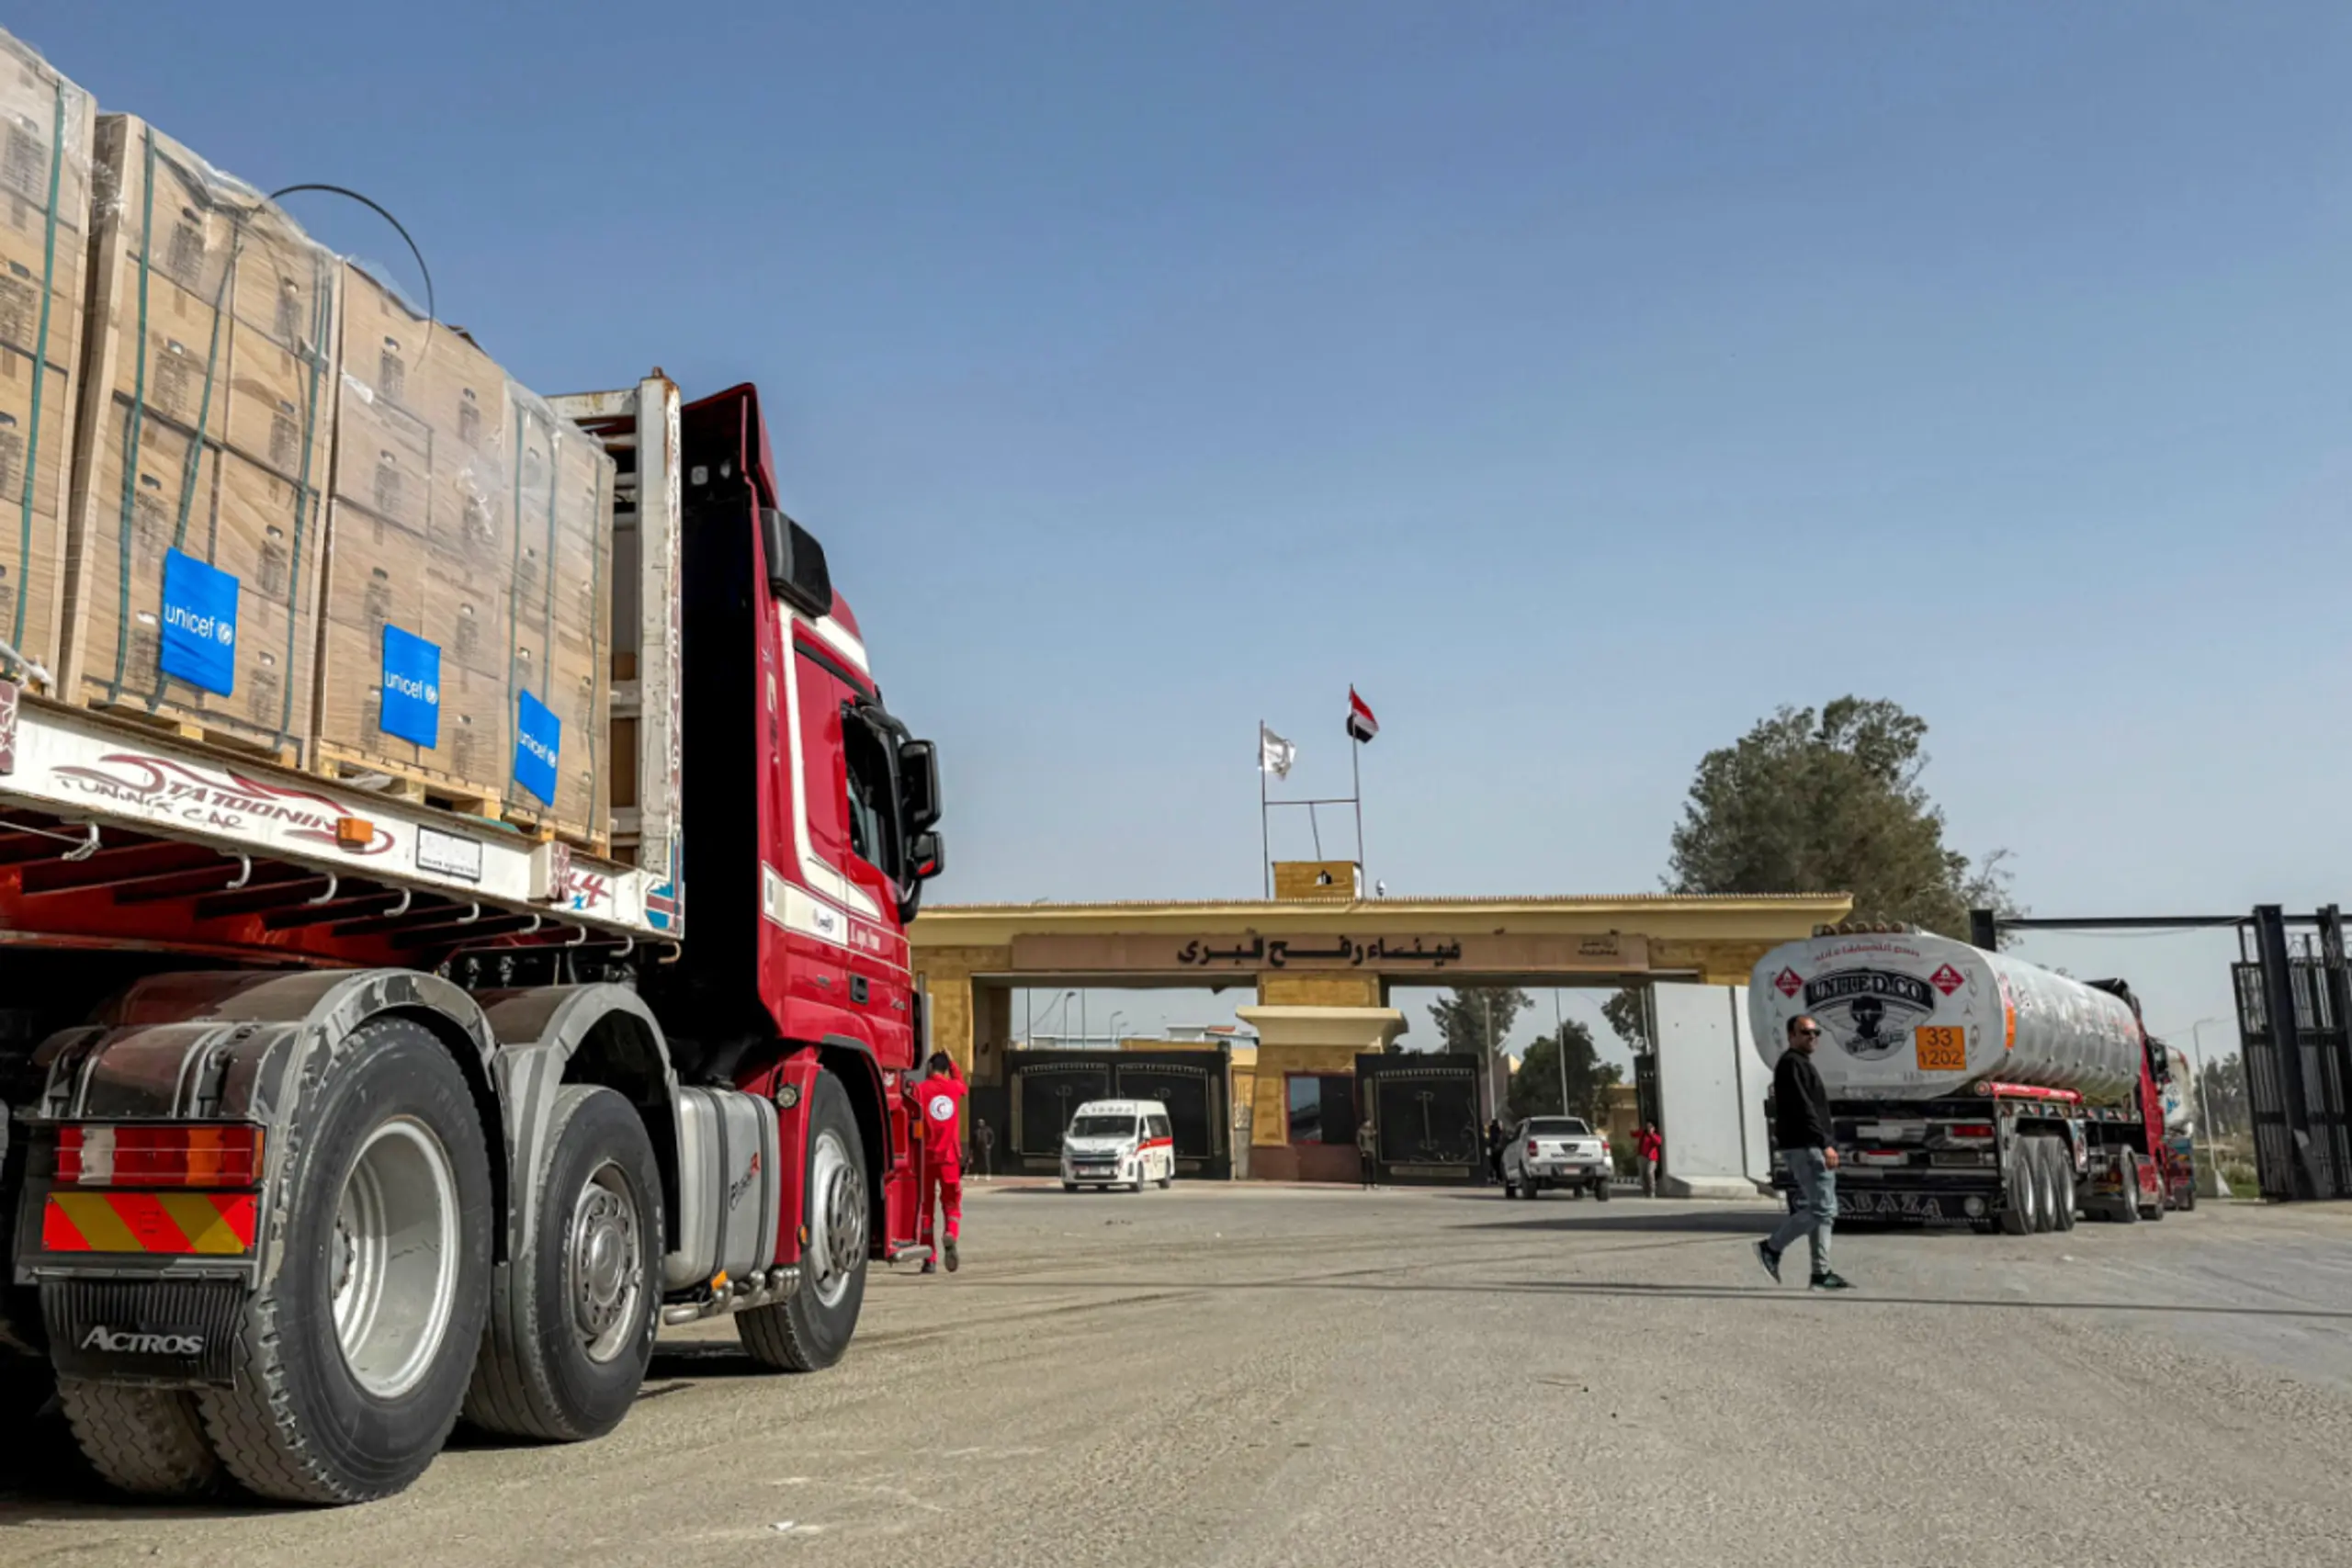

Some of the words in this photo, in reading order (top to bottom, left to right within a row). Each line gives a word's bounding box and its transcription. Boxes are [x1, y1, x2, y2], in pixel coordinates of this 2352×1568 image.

[164, 603, 215, 639] unicef
[384, 671, 424, 700] unicef
[518, 728, 548, 760] unicef
[1269, 934, 1363, 967] رفح
[1926, 1027, 1953, 1047] 33
[1920, 1049, 1962, 1066] 1202
[81, 1325, 205, 1354] ACTROS
